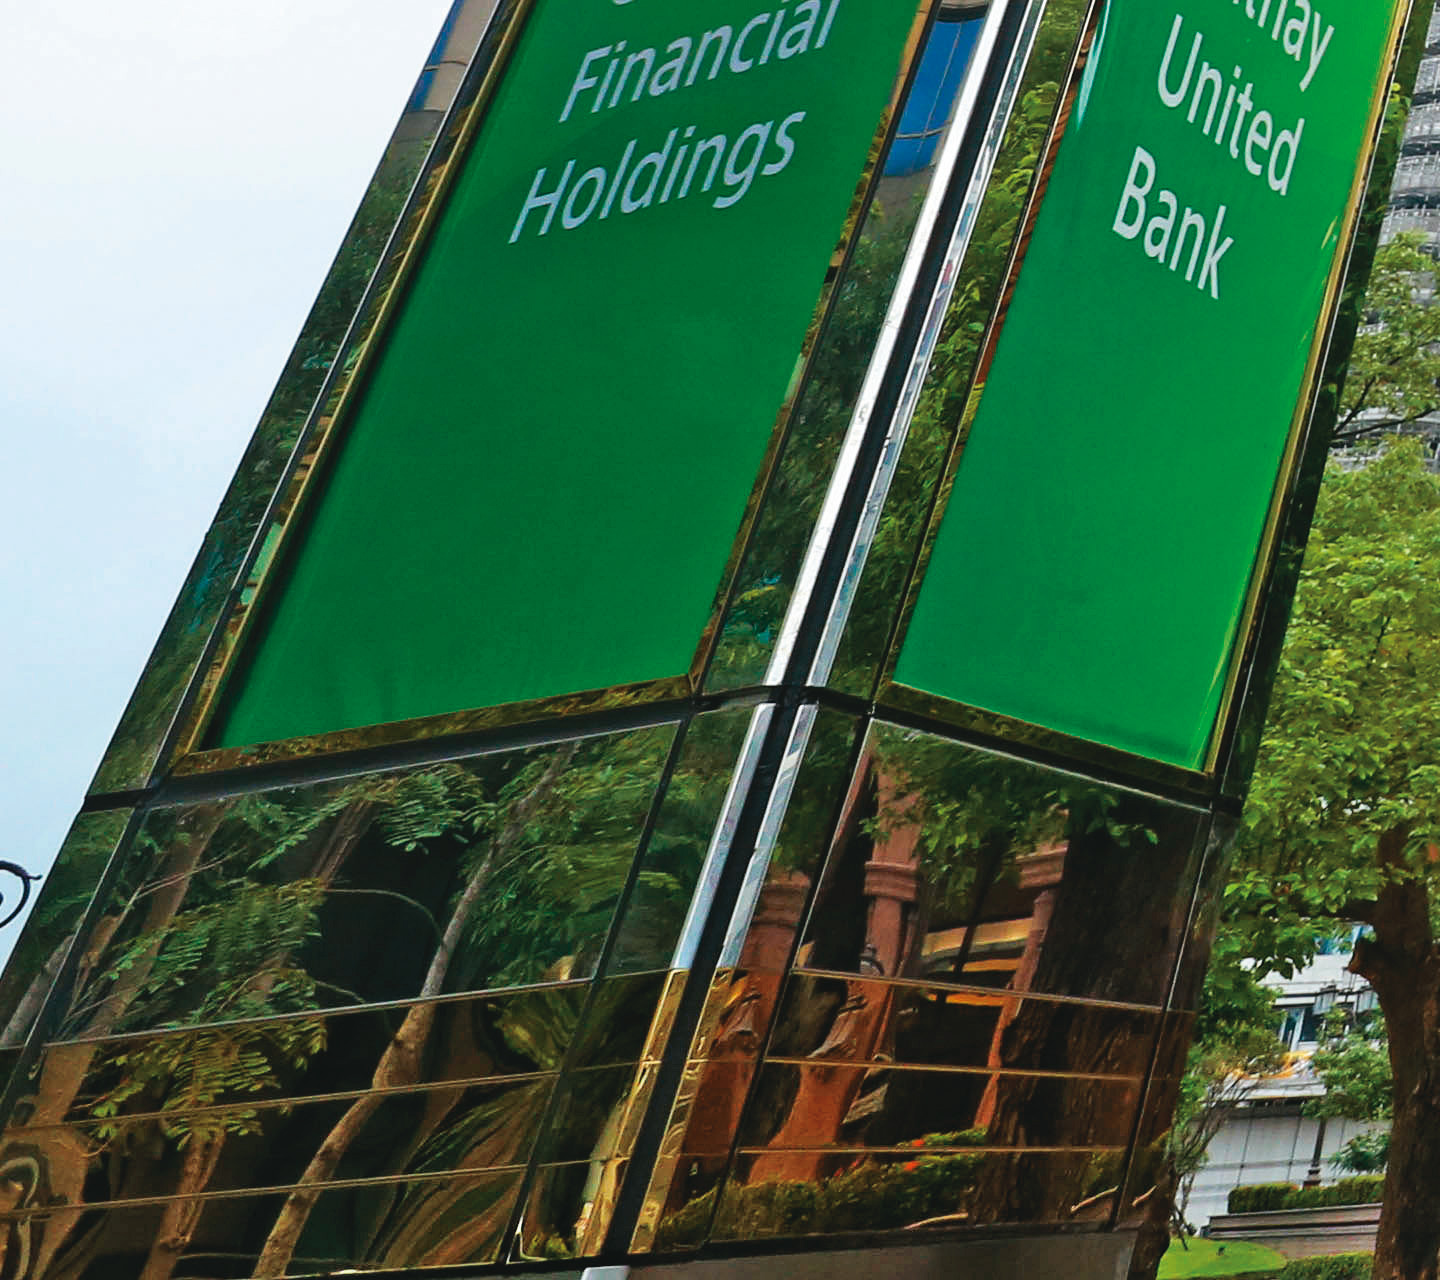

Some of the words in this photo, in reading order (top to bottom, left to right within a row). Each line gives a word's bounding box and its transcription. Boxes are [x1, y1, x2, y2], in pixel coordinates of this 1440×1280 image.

[507, 108, 806, 245] Holdings
[1156, 12, 1306, 197] United
[1111, 144, 1236, 301] Bank
